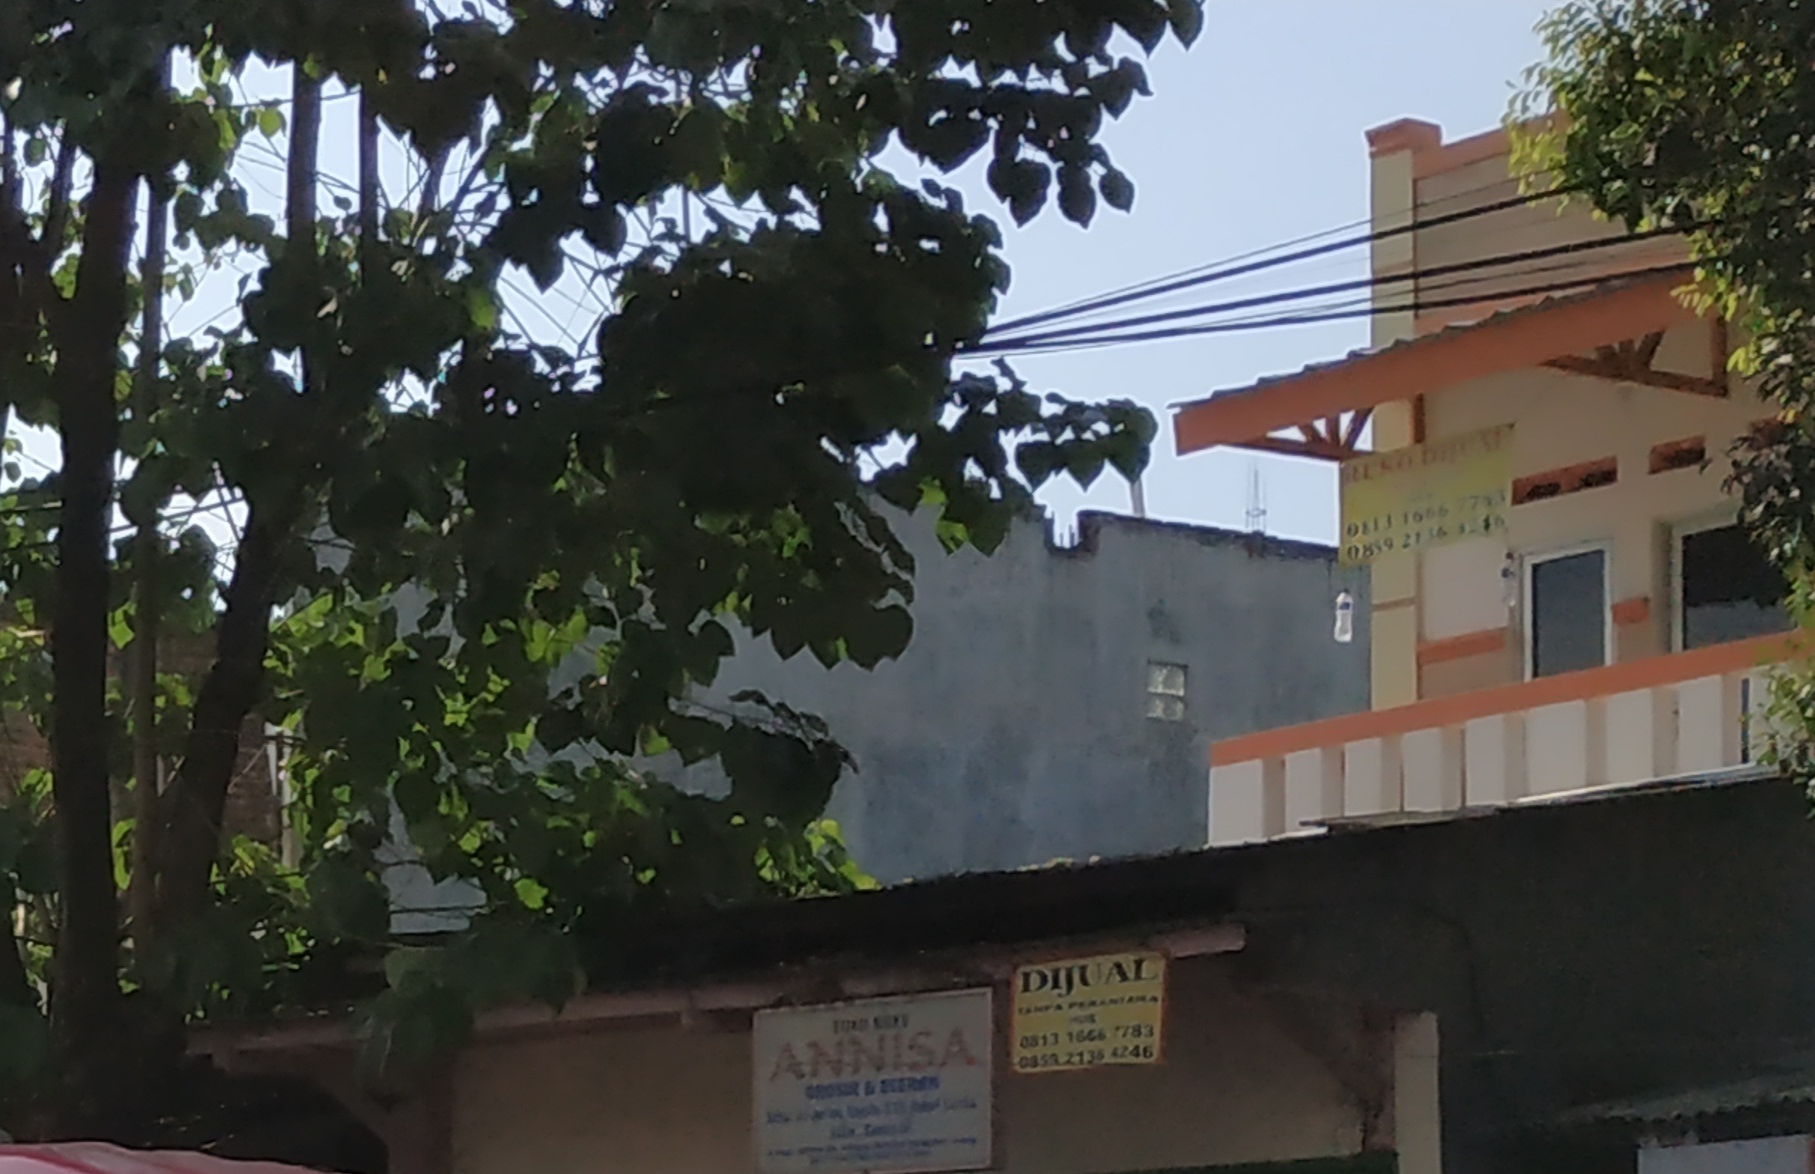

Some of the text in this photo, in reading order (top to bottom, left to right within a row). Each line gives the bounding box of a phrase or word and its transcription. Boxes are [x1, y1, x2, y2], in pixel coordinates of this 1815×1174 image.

[1020, 957, 1160, 998] DIJUAL
[769, 1026, 978, 1082] ANNISA
[1019, 1033, 1059, 1050] 0813
